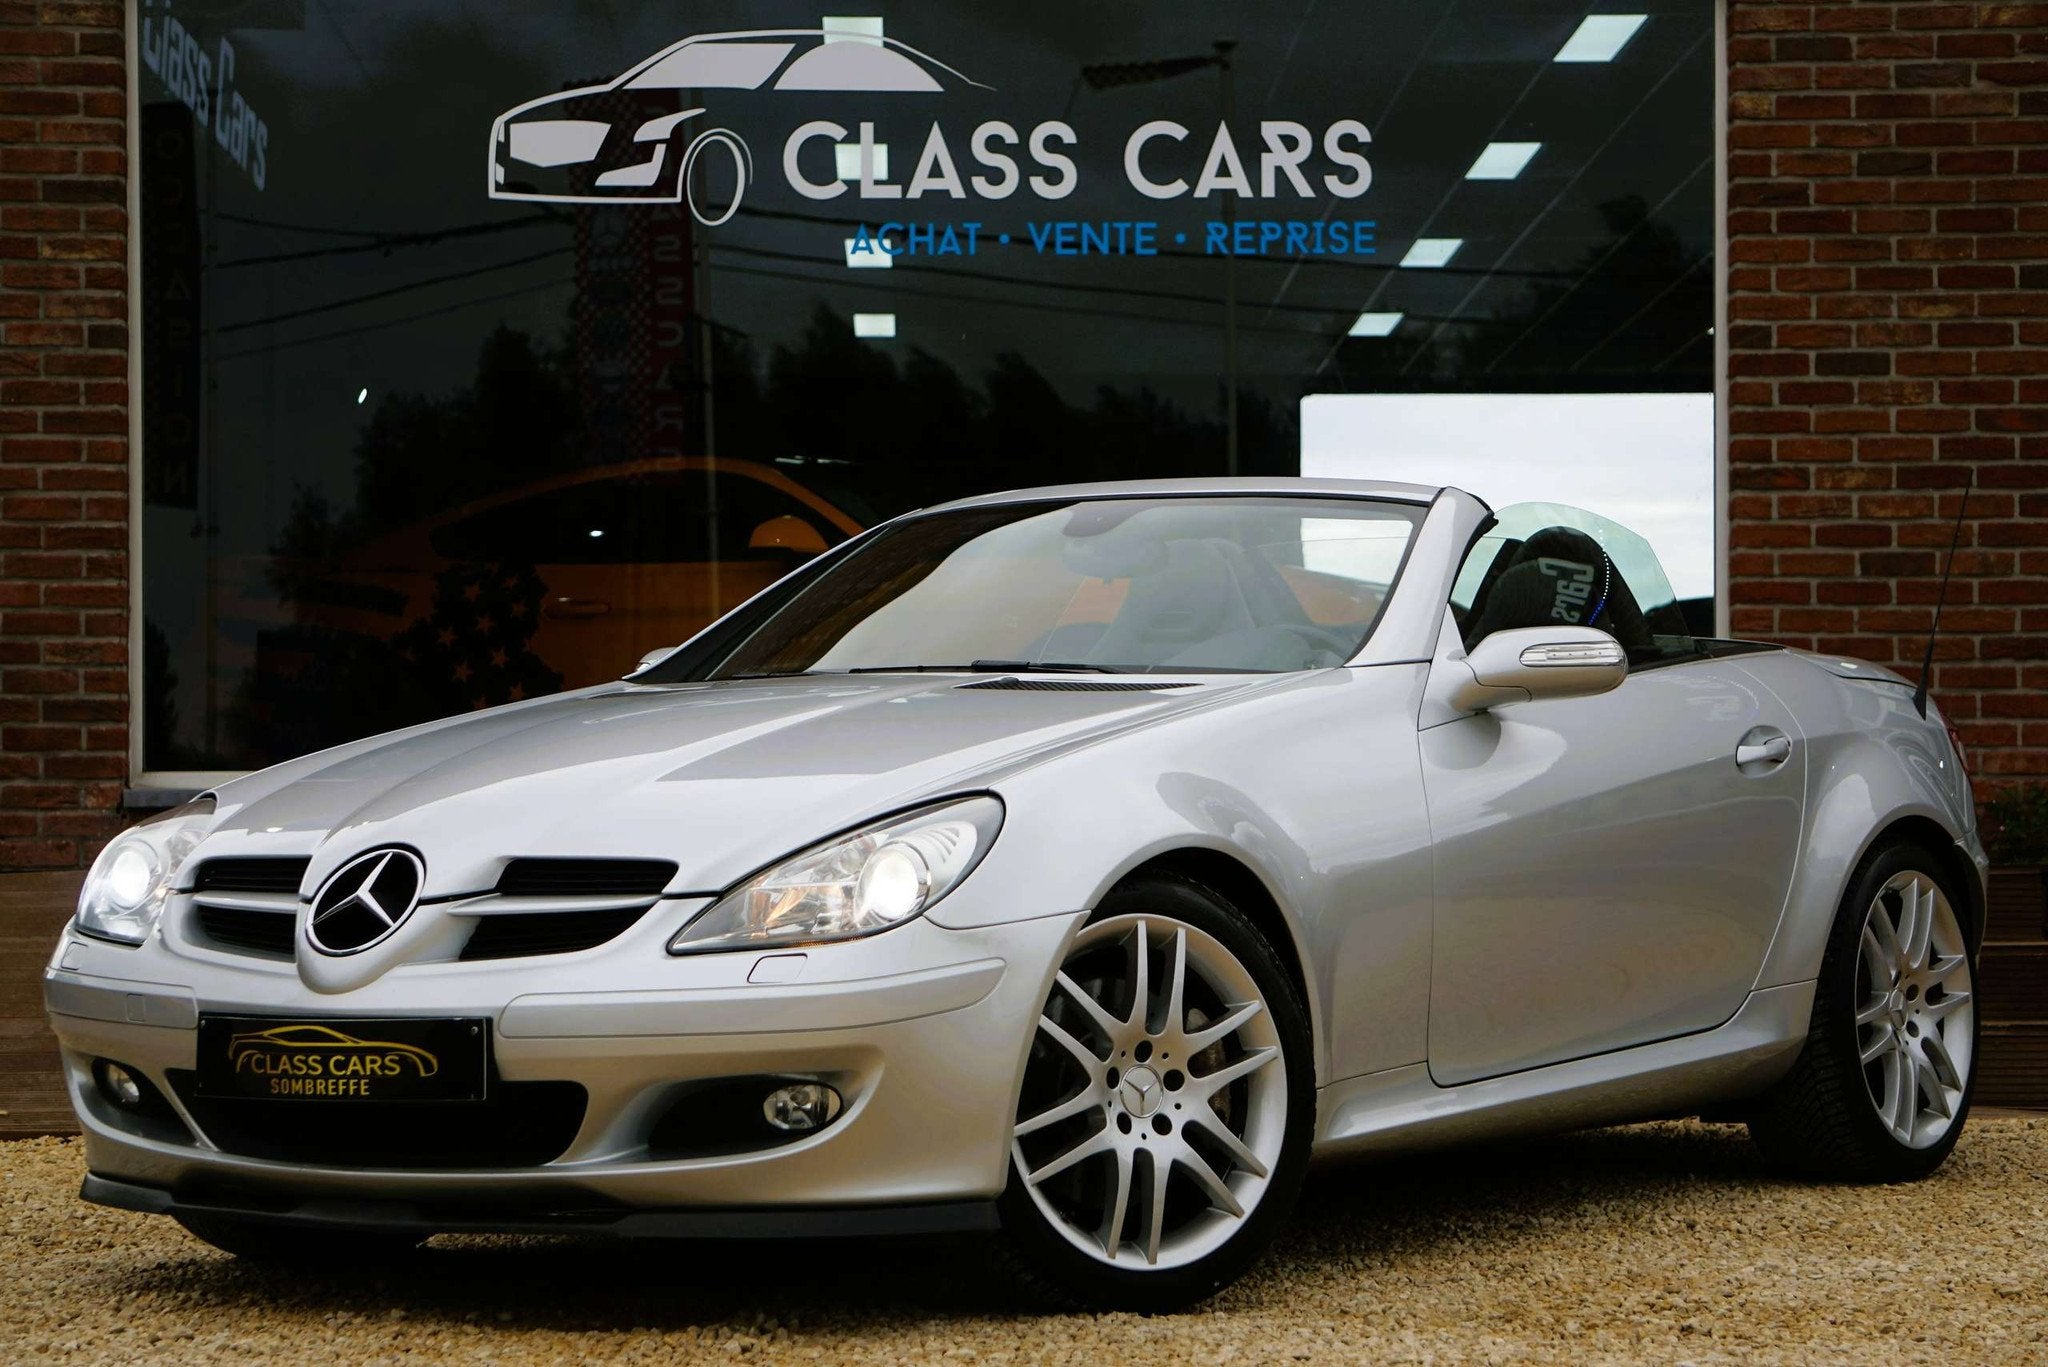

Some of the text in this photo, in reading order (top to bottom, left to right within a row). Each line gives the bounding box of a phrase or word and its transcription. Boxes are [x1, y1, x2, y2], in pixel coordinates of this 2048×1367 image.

[215, 36, 269, 192] Cars
[782, 119, 1373, 199] CLASS CARS
[850, 221, 1377, 255] ACHAT VENTE REPRISE
[251, 1053, 401, 1077] CLASS CARS
[270, 1077, 371, 1096] SOMBREFFE
